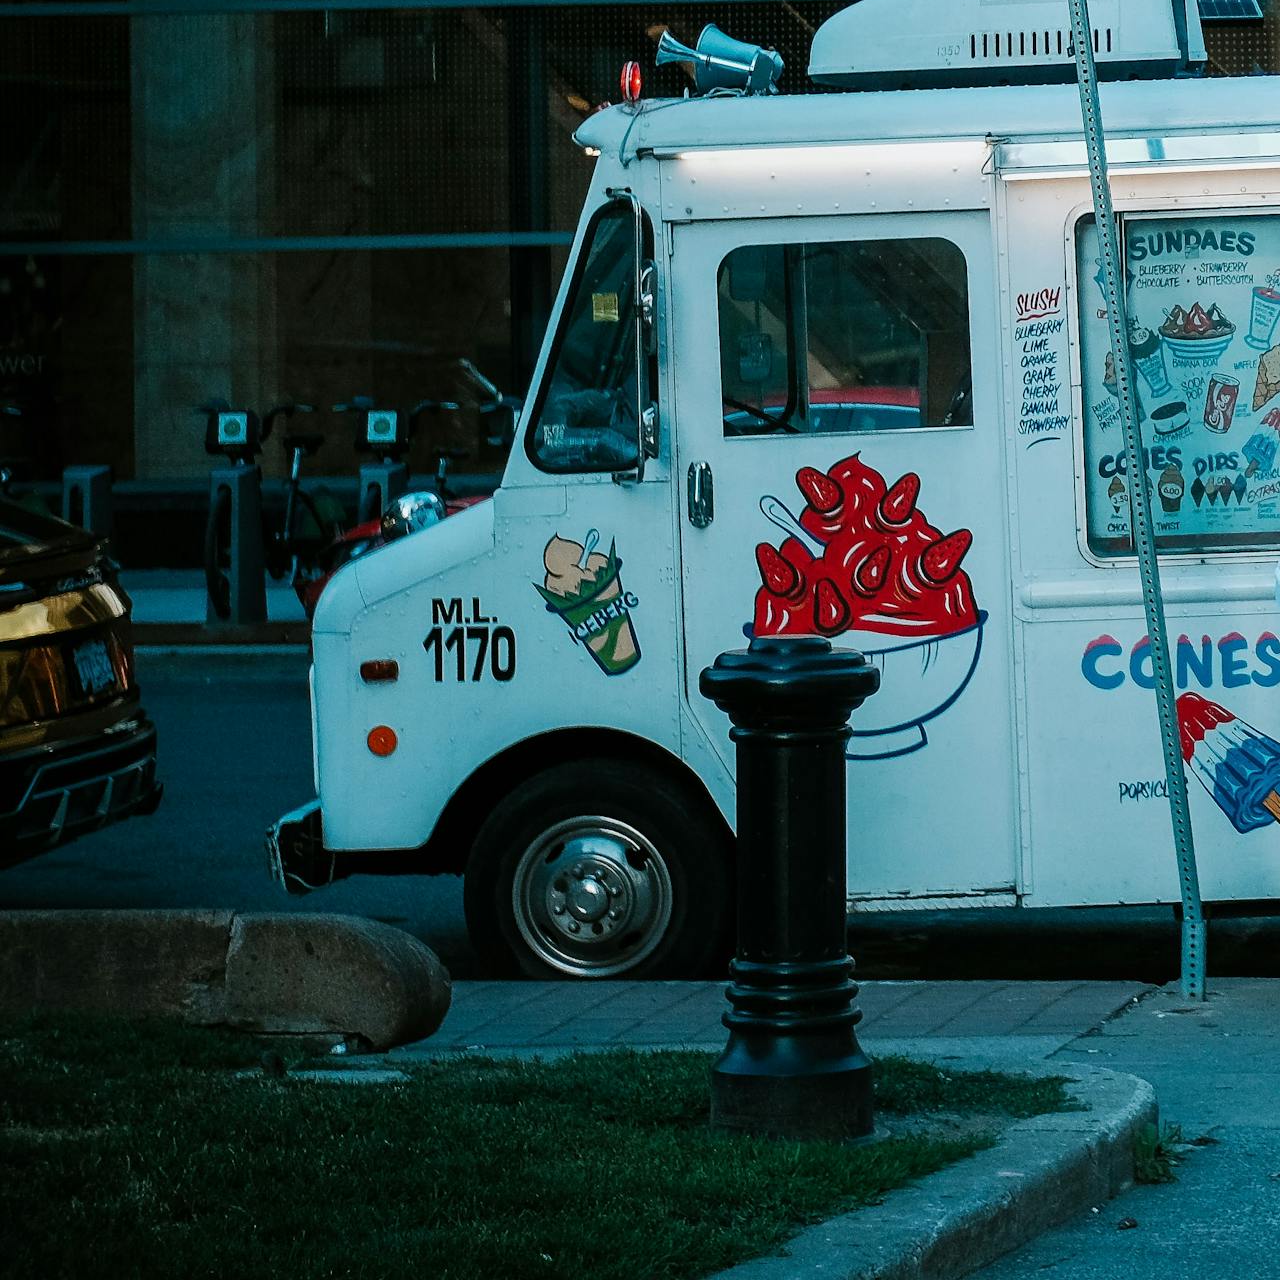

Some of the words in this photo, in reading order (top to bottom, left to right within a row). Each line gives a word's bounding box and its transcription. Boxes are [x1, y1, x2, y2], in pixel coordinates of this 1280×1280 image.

[1128, 228, 1256, 261] SUNDAES
[1139, 263, 1186, 277] BLUEBERRY
[1200, 261, 1249, 274] STRAWBERRY
[1136, 277, 1180, 289] CHOCOLATE
[1196, 274, 1254, 286] BUTTERSCOTCH
[1016, 287, 1061, 315] SLUSH
[1015, 318, 1065, 341] BLUEBERRY
[1023, 338, 1049, 353] LIME
[1020, 351, 1058, 368] ORANGE
[1172, 358, 1200, 369] BANANA
[1233, 360, 1258, 370] WAFFLE
[1023, 367, 1056, 385] GRAPE
[1181, 376, 1206, 392] SODA
[1022, 383, 1062, 400] CHERRY
[1186, 389, 1204, 401] POP
[1020, 399, 1059, 416] BANANA
[1017, 415, 1071, 435] STRAWBERRY
[1098, 445, 1183, 478] COES
[1192, 451, 1240, 477] DIPS
[1163, 487, 1180, 496] 6.00
[1247, 481, 1280, 504] EXTRAS
[1156, 522, 1180, 531] TWIST
[431, 597, 498, 625] M.L.
[568, 590, 639, 646] ICEBERG
[422, 625, 516, 682] 1170
